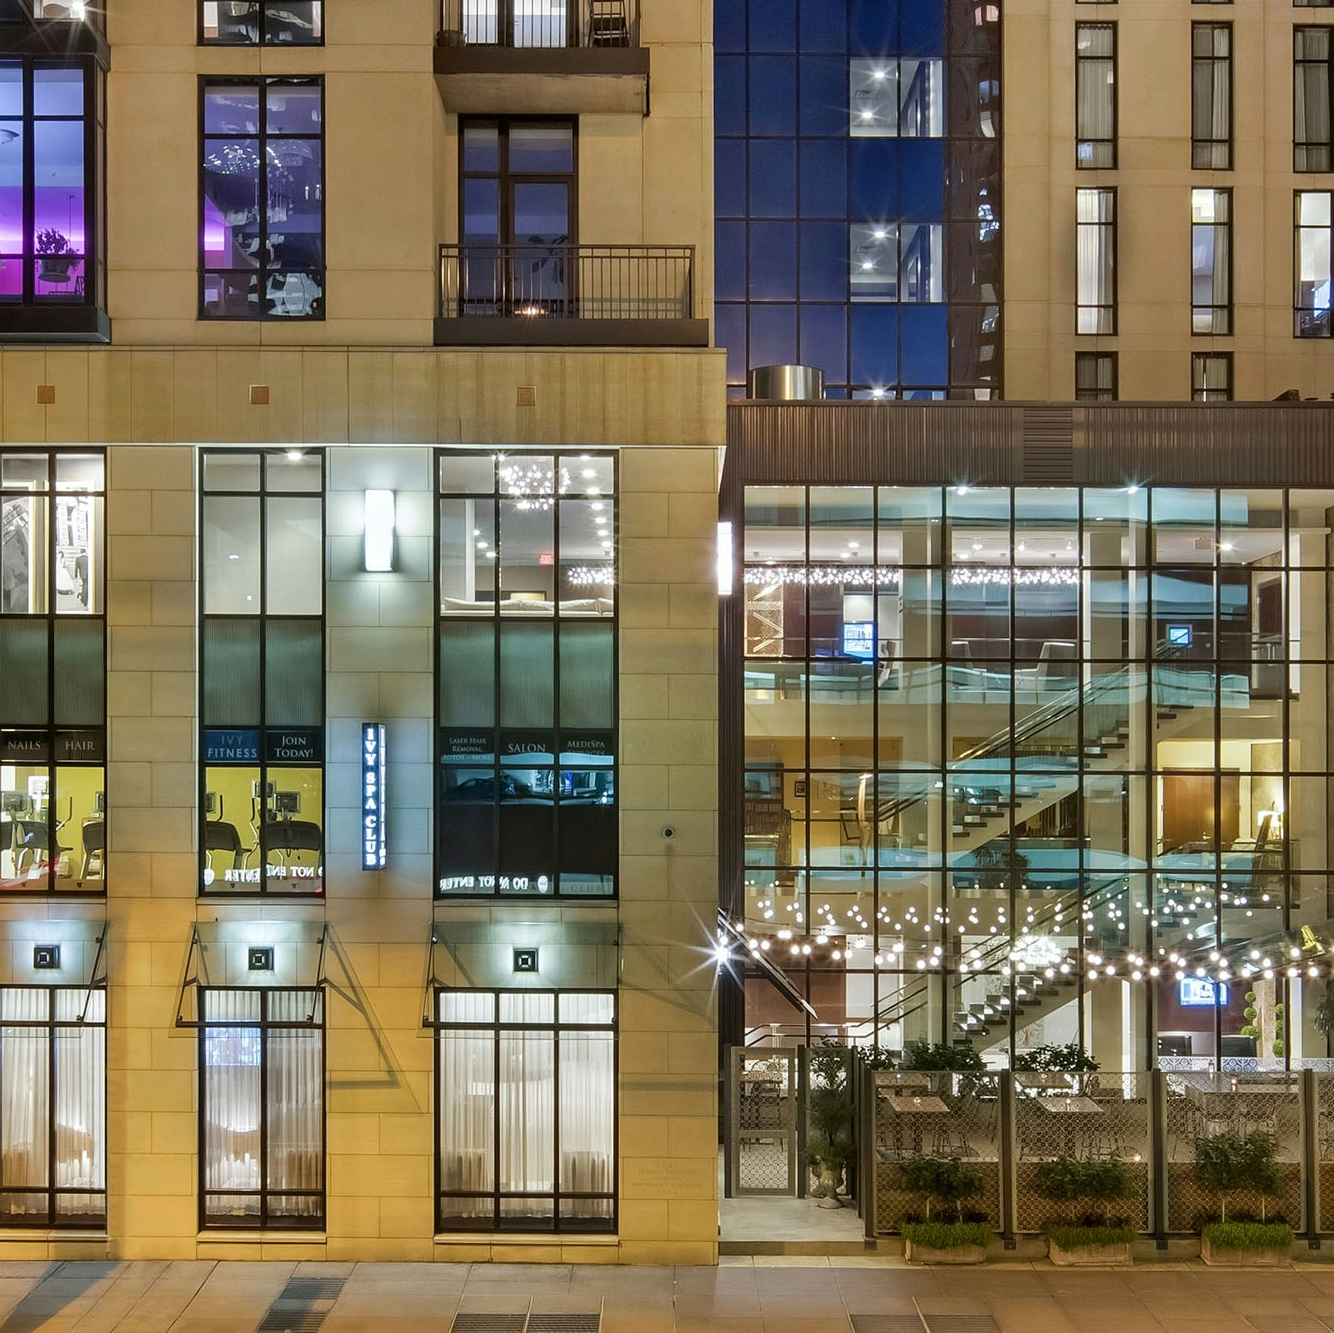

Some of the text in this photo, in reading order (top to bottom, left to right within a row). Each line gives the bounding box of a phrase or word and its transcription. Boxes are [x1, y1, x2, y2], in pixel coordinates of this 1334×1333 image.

[221, 735, 243, 744] IVY
[8, 741, 41, 750] NAILS
[65, 741, 95, 750] HAIR
[508, 743, 546, 753] SALON
[207, 748, 258, 758] FITNESS
[364, 728, 377, 865] IVY SPA CLUB
